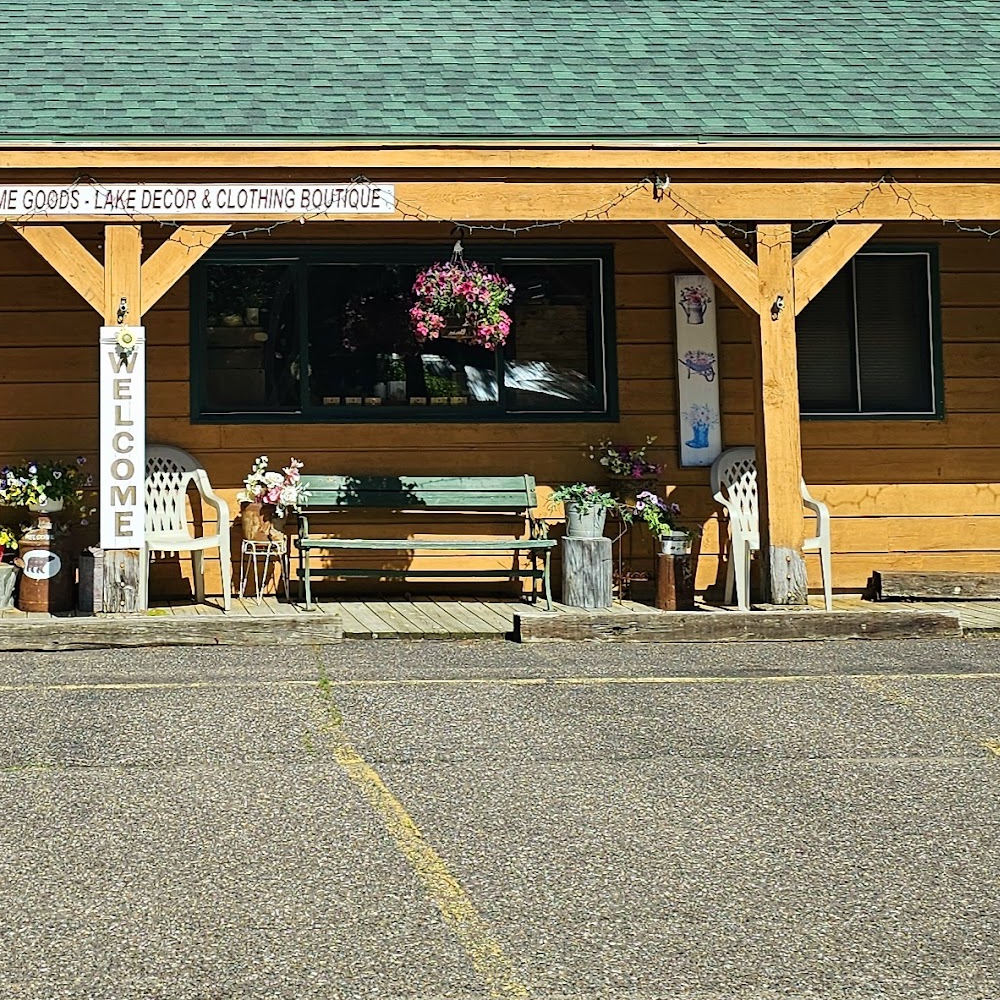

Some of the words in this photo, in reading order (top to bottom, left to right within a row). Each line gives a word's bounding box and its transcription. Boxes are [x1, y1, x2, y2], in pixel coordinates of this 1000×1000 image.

[22, 189, 80, 210] GOODS
[94, 189, 137, 210] LAKE
[141, 189, 197, 210] DECOR
[201, 189, 212, 209] &
[216, 188, 296, 209] CLOTHING
[300, 187, 382, 210] BOUTIQUE
[107, 351, 138, 537] WELCOME
